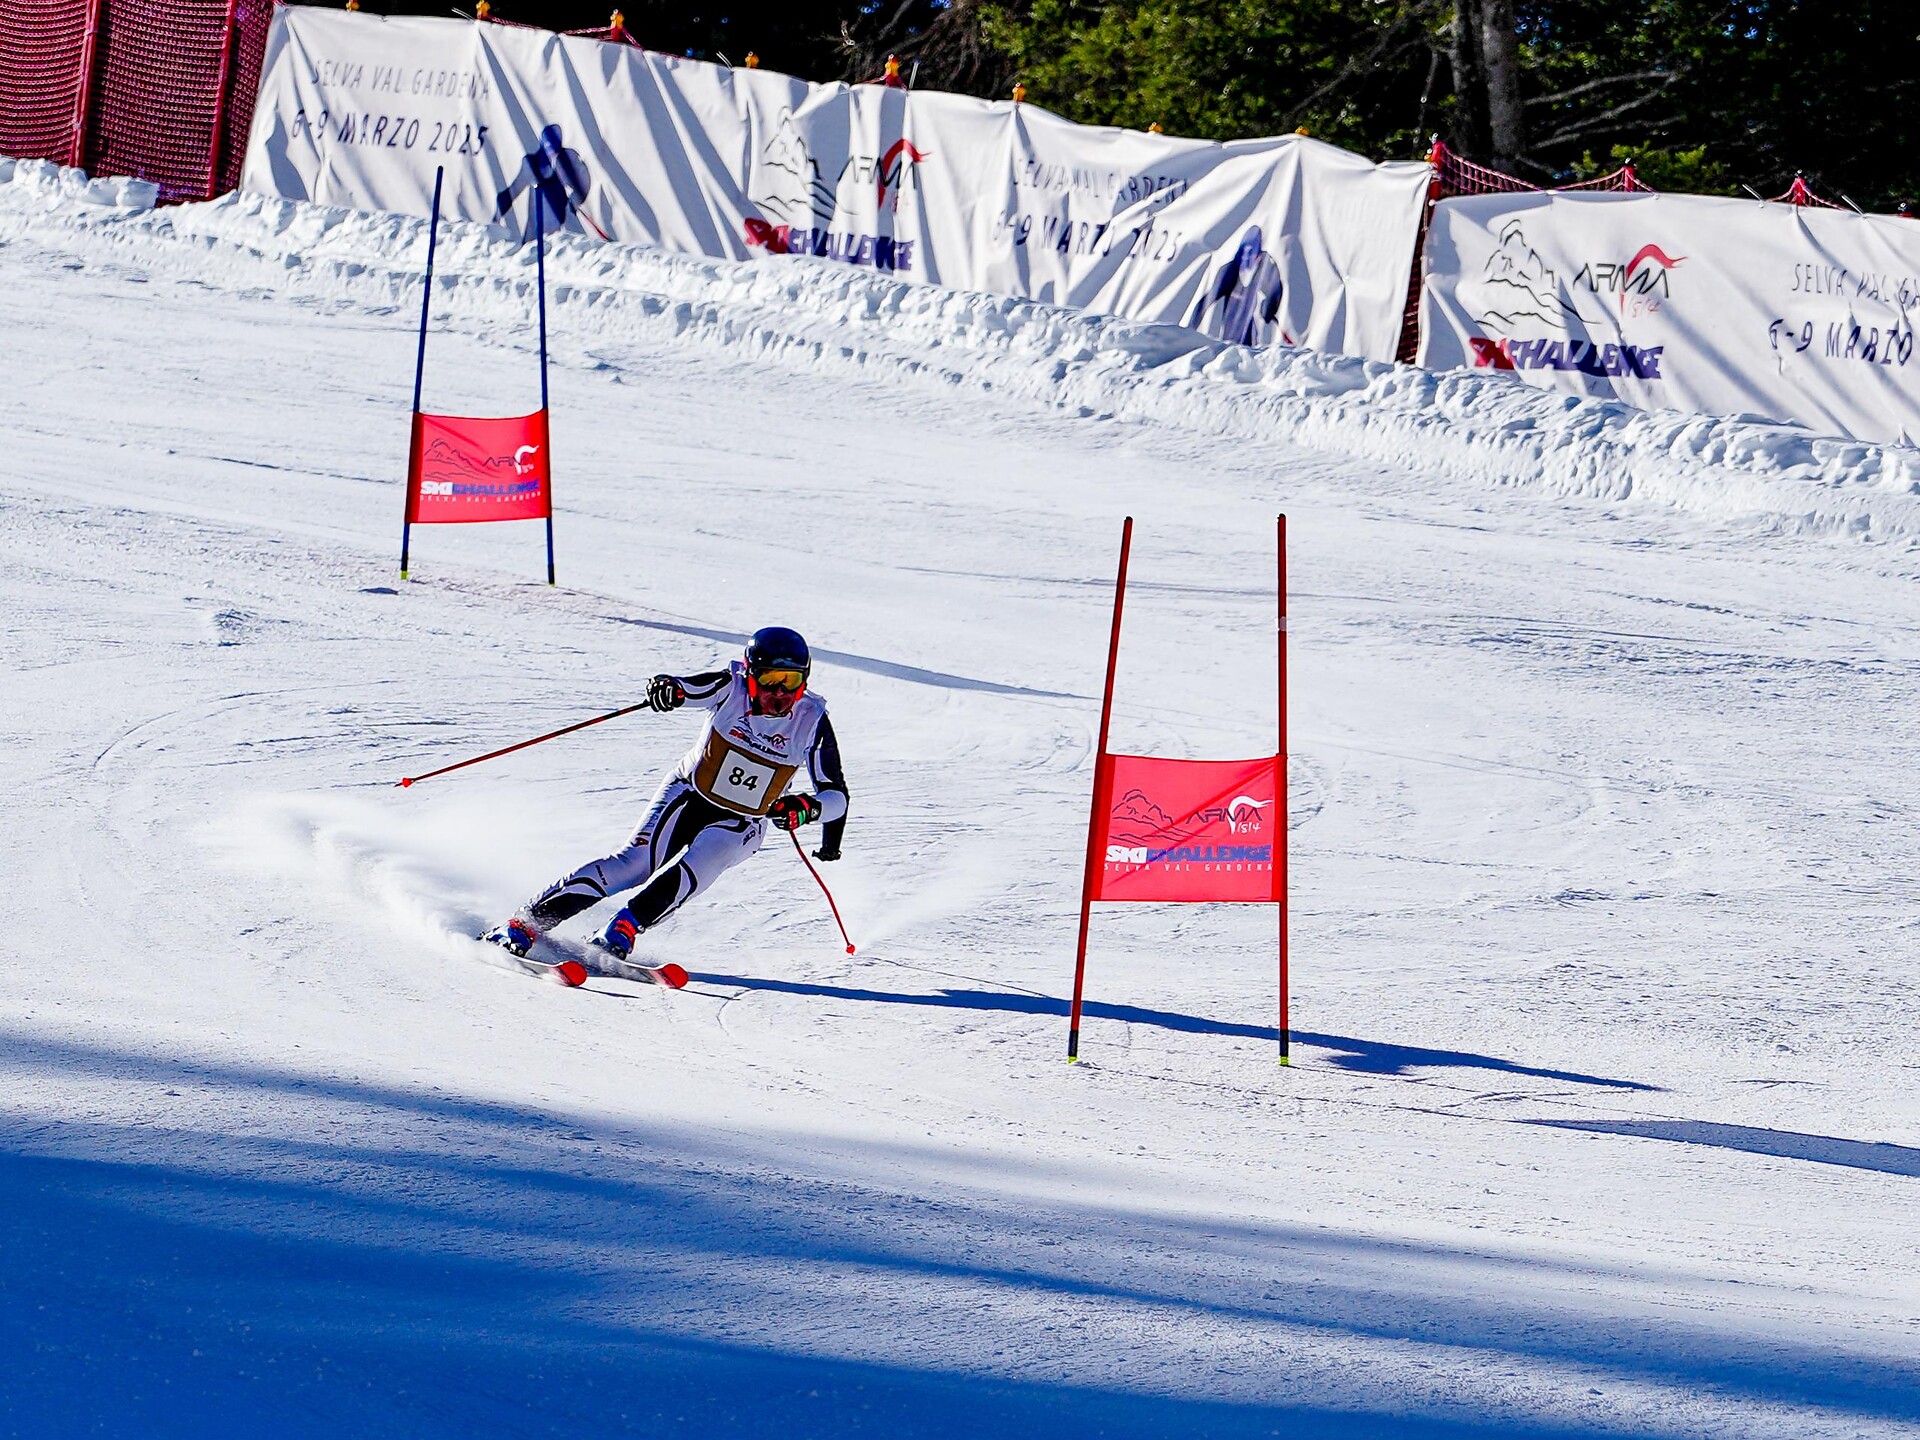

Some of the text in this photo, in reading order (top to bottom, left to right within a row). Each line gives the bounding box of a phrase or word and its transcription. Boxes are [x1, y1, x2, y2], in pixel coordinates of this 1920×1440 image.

[311, 59, 490, 101] SELVA VAL GARDENA
[292, 108, 489, 156] 6-9 MARZO 2025
[1012, 159, 1066, 191] ELVA
[1791, 263, 1848, 296] SELVA
[1856, 272, 1890, 302] VAL
[1825, 321, 1913, 366] MARZO
[728, 766, 759, 791] 84
[1104, 863, 1273, 872] SELVA VAL GARDENA
